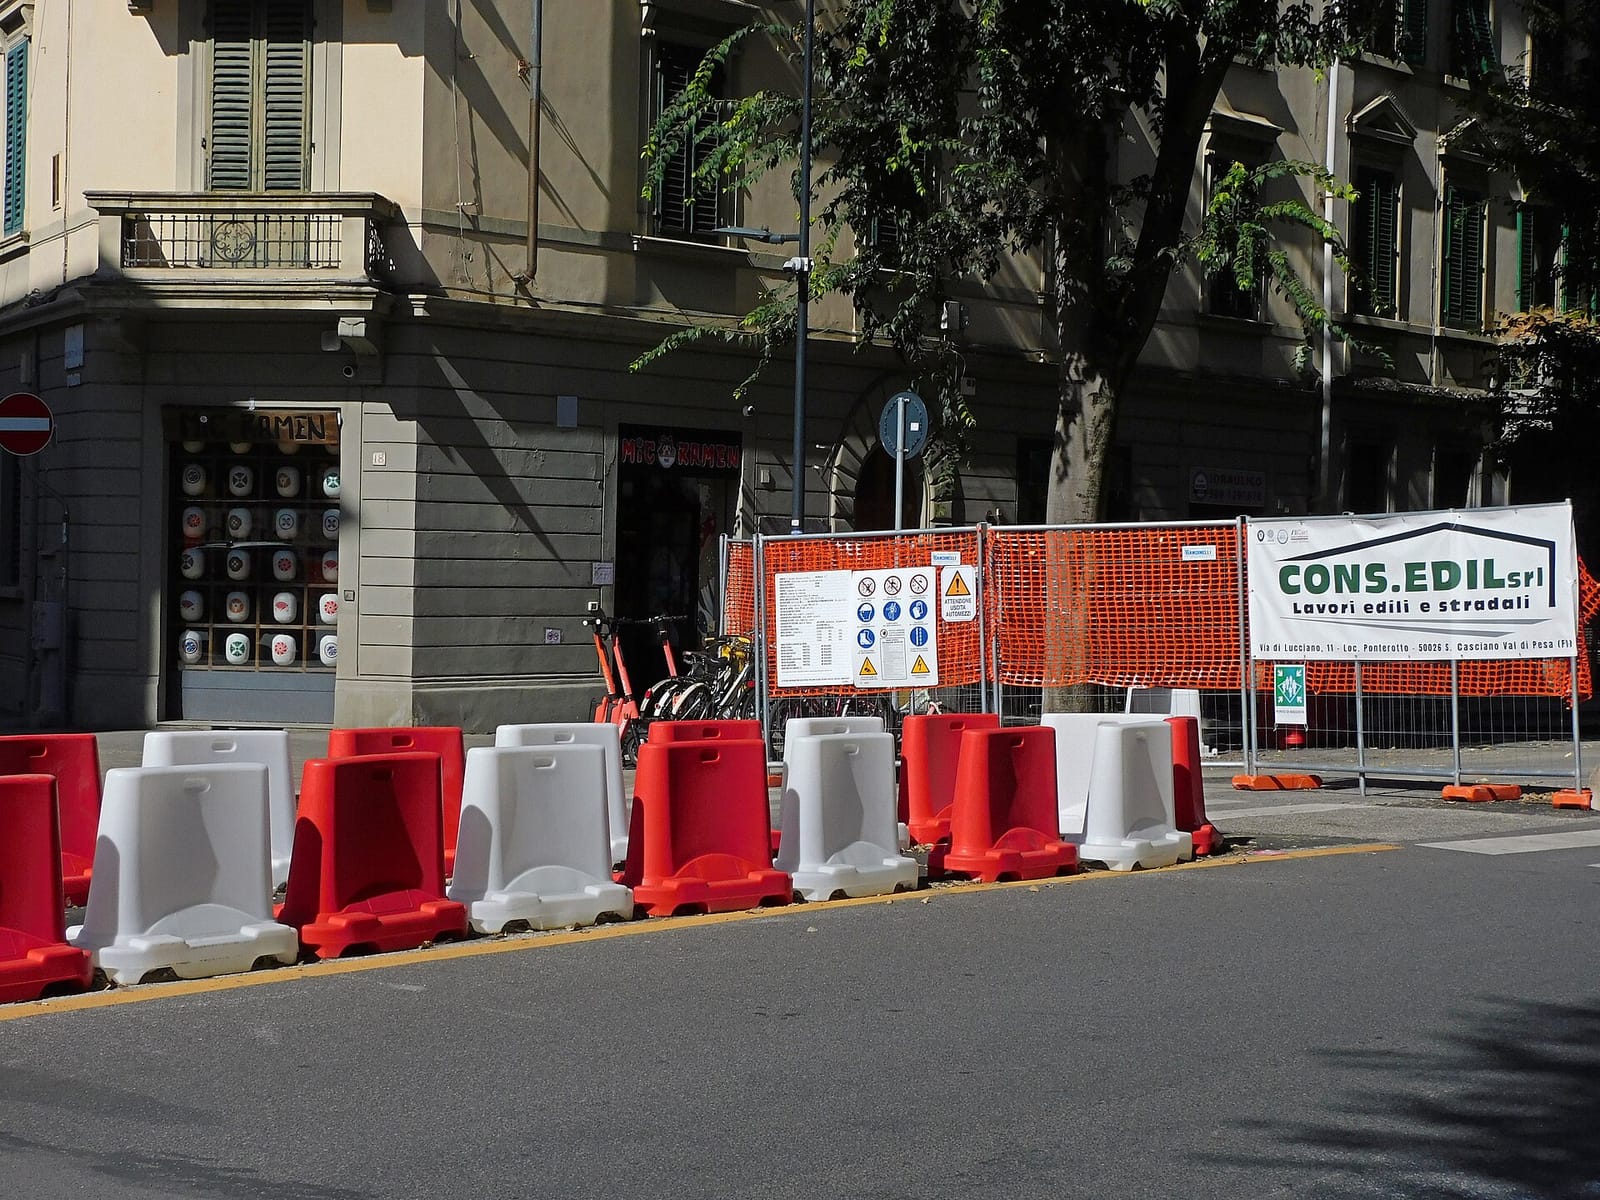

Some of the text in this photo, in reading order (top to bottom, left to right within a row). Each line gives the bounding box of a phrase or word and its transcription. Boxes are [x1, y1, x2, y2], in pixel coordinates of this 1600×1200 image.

[374, 453, 385, 464] 18
[678, 441, 740, 469] RAMEN
[1293, 595, 1530, 614] Lavori edili e stradali
[1259, 643, 1270, 652] Via
[1273, 643, 1281, 652] di
[1284, 643, 1324, 653] Lucciano,
[1327, 643, 1334, 652] 11
[1343, 643, 1360, 652] Loc.
[1363, 643, 1409, 652] Ponterotto
[1418, 643, 1442, 652] 50026
[1457, 641, 1499, 651] Casciano
[1502, 641, 1517, 650] Val
[1520, 640, 1529, 650] di
[1532, 639, 1554, 649] Pesa
[1557, 638, 1573, 648] (FI)
